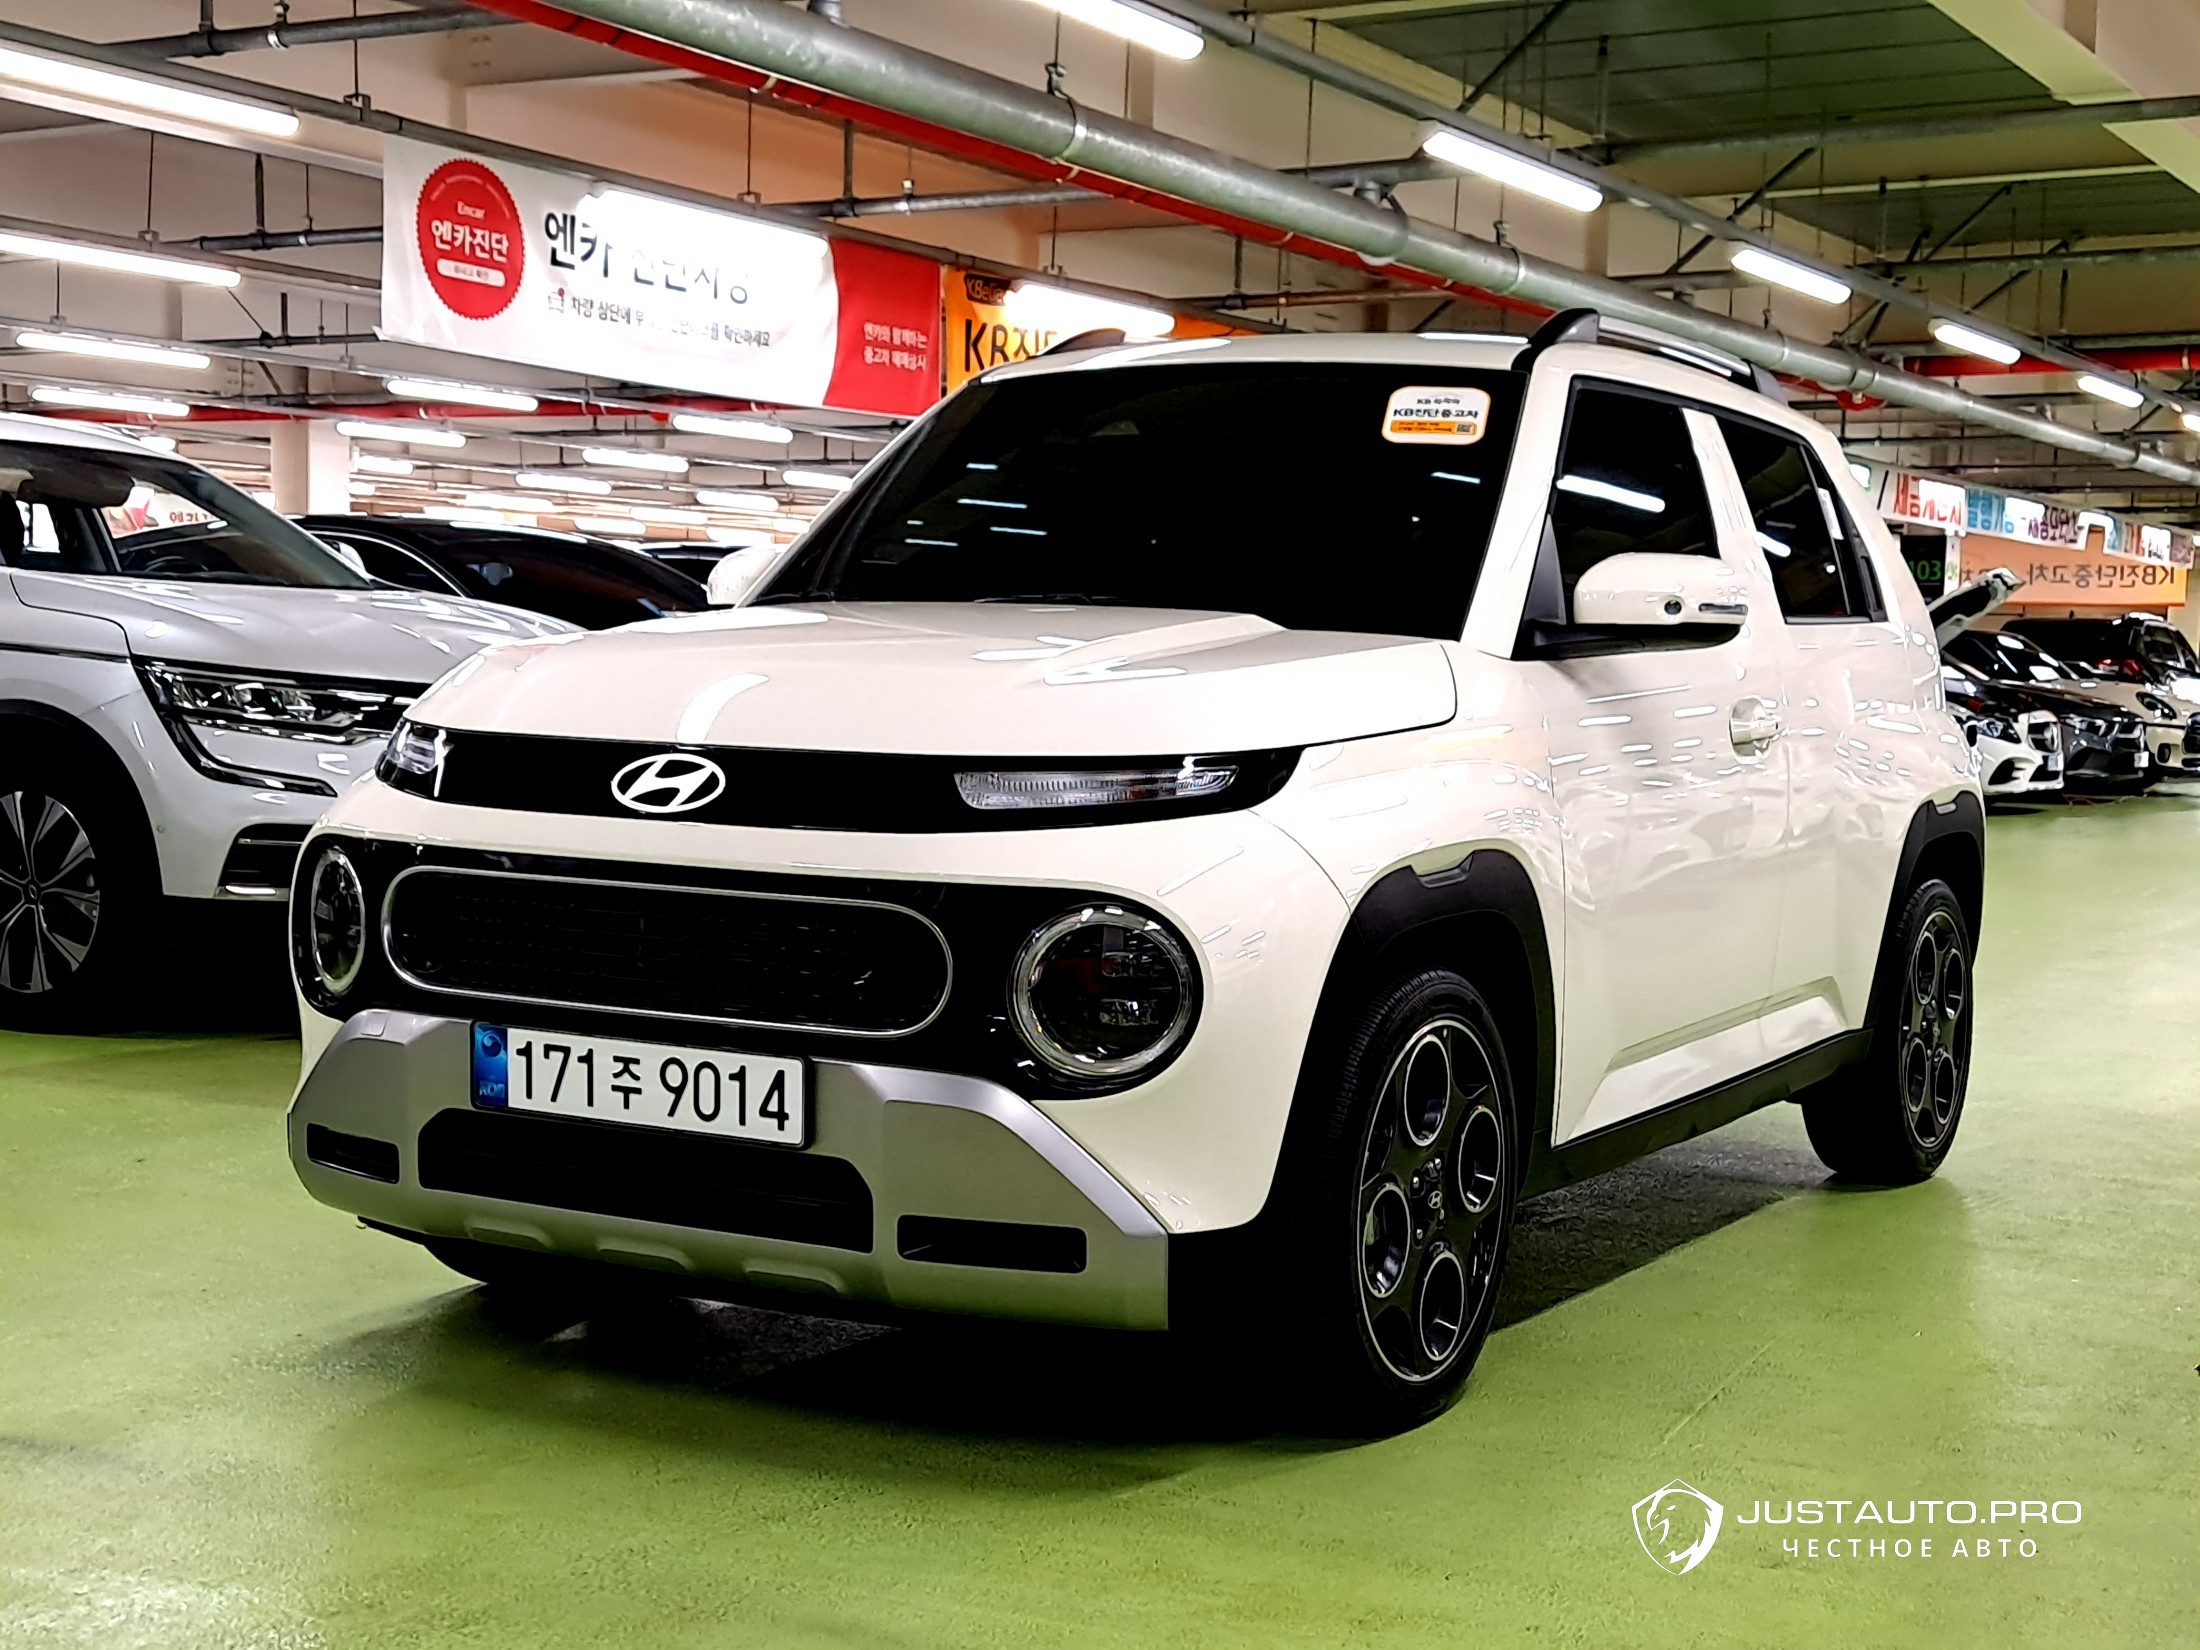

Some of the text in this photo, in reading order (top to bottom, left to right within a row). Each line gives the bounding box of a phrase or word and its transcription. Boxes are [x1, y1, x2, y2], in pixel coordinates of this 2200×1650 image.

[431, 219, 509, 263] 엔카진단
[571, 296, 594, 318] 차량
[597, 301, 631, 324] 상단에
[659, 1056, 790, 1132] 9014
